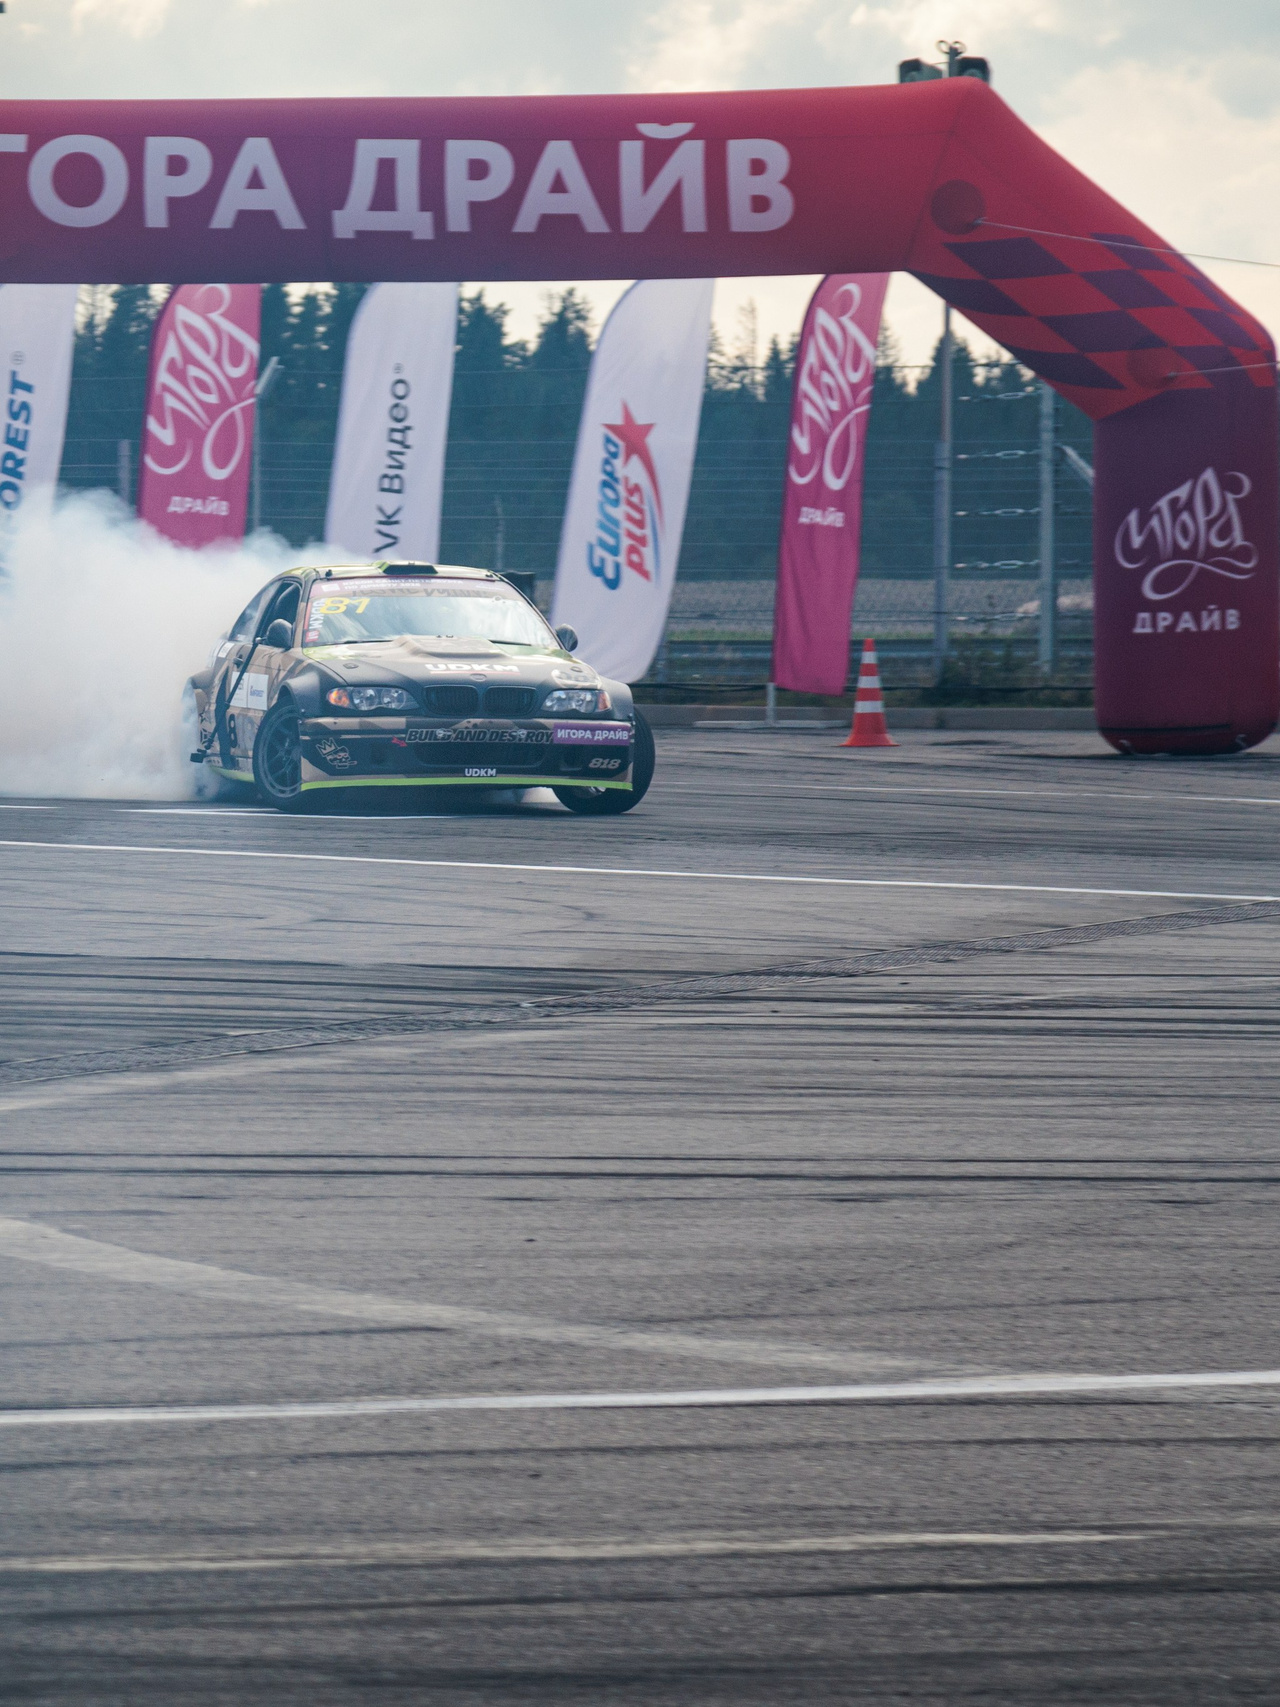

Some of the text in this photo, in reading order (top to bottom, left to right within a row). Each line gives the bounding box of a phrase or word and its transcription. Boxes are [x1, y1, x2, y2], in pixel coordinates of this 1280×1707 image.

[332, 121, 795, 240] ДРАЙВ
[373, 377, 414, 555] VK Видео
[168, 496, 229, 516] ДРАЙВ
[798, 506, 846, 527] ДРАЙВ
[320, 597, 370, 614] 81
[1132, 605, 1241, 633] ДРАЙВ
[426, 664, 519, 672] UDKM
[453, 729, 486, 743] AND
[557, 728, 629, 741] ИГОРА ДРАЙВ
[588, 757, 620, 770] 818
[464, 768, 497, 777] UDKM
